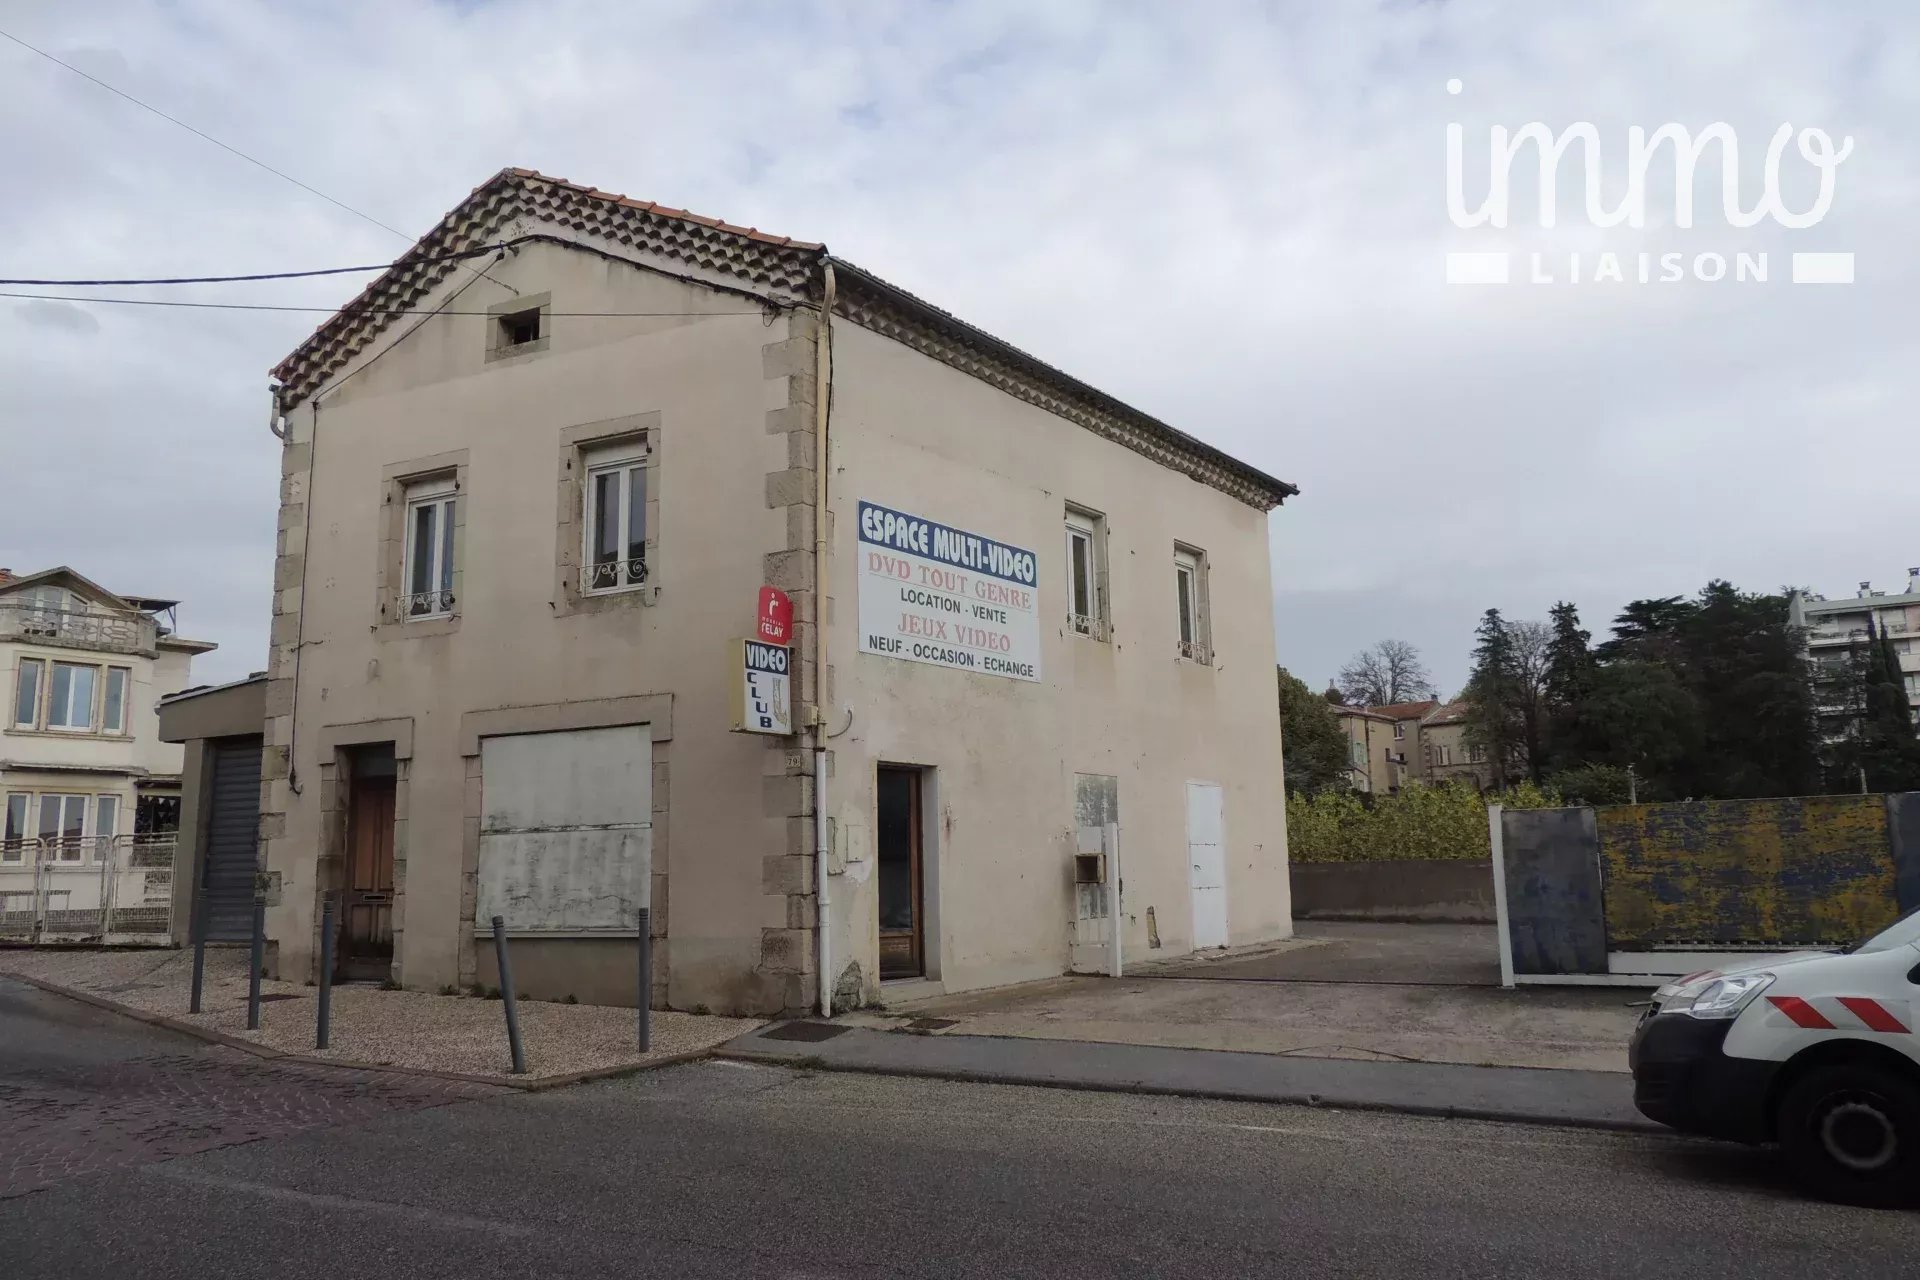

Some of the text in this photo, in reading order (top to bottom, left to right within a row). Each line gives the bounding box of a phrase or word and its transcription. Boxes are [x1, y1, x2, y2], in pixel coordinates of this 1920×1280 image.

[862, 507, 1034, 583] ESPACE MULTI-VIDEO
[868, 552, 1032, 610] DVD TOUT GENRE
[901, 587, 961, 614] LOCATION
[971, 604, 1007, 625] VENTE
[897, 612, 1011, 653] JEUX VIDEO
[746, 643, 787, 672] VIDEO
[869, 634, 902, 654] NEUF
[913, 643, 974, 667] OCCASION
[984, 656, 1034, 678] ECHANGE
